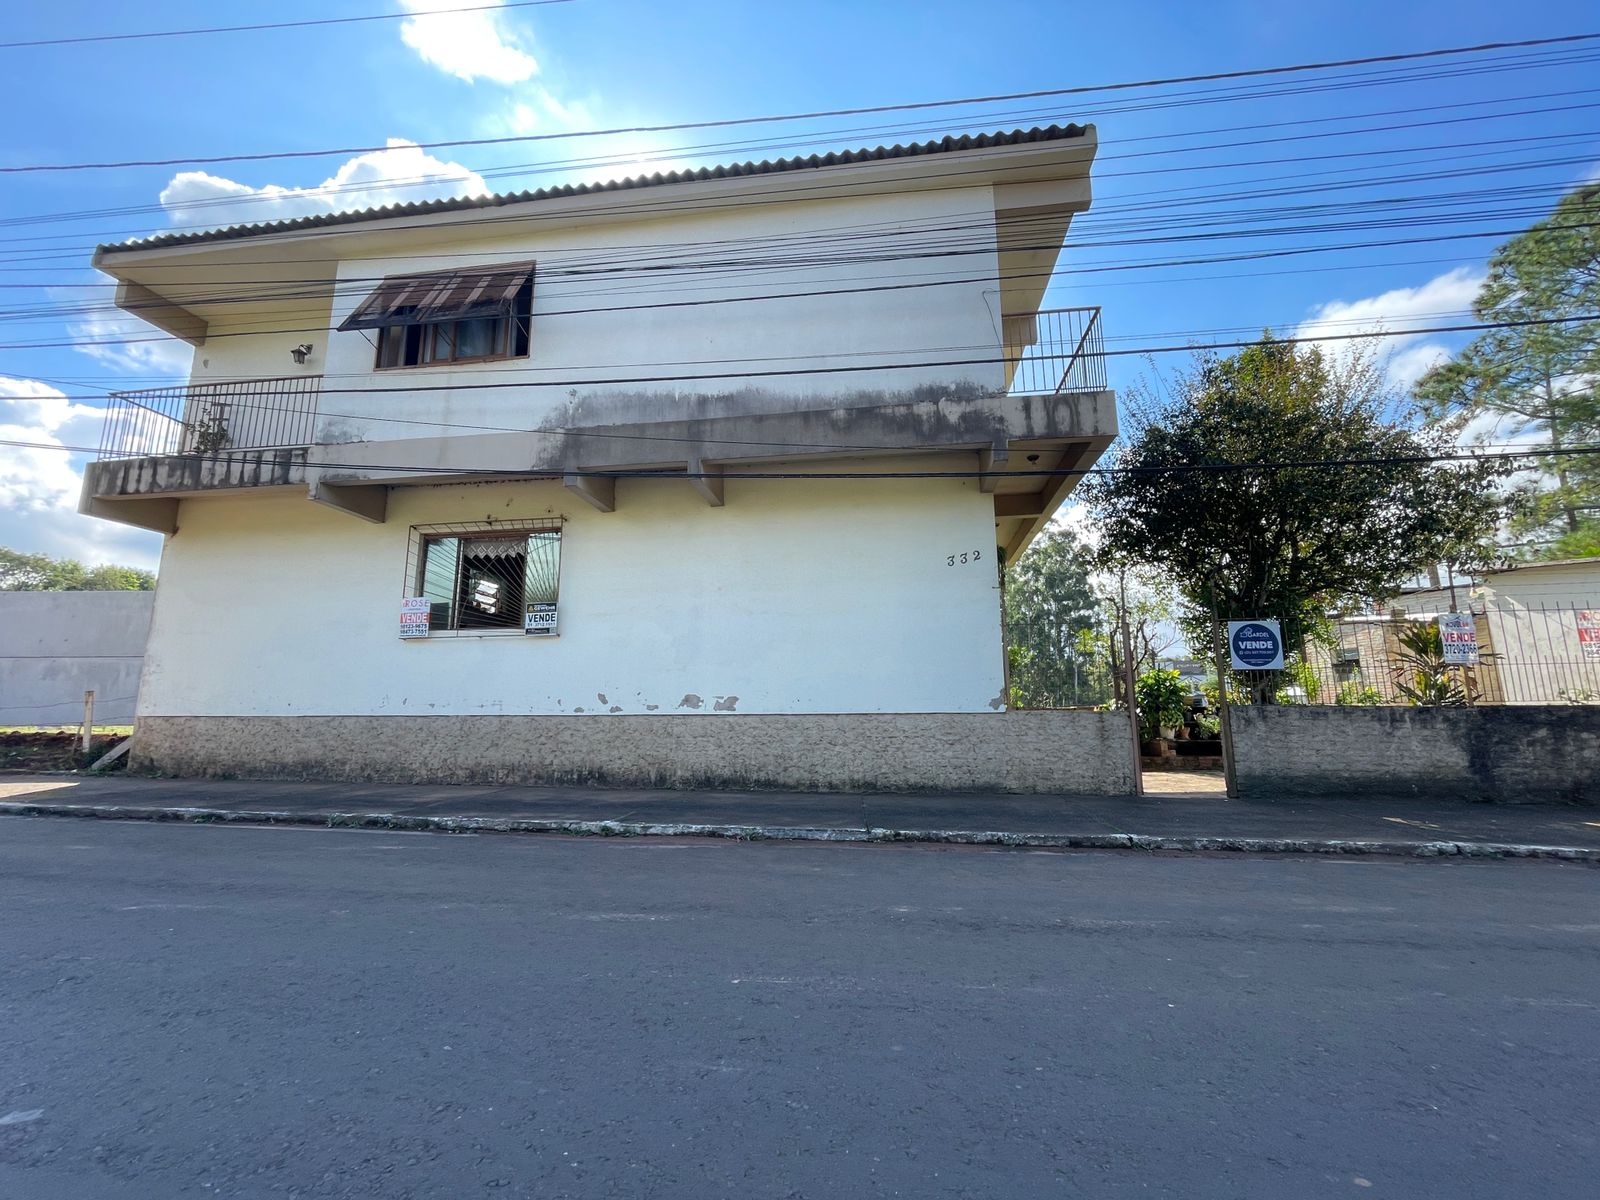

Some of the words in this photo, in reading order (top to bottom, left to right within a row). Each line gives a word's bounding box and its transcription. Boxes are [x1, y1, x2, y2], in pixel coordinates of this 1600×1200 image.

[946, 550, 981, 567] 332
[401, 612, 428, 623] VENDE
[528, 613, 556, 623] VENDE
[1443, 632, 1476, 643] VENDE
[1238, 641, 1274, 649] VENDE
